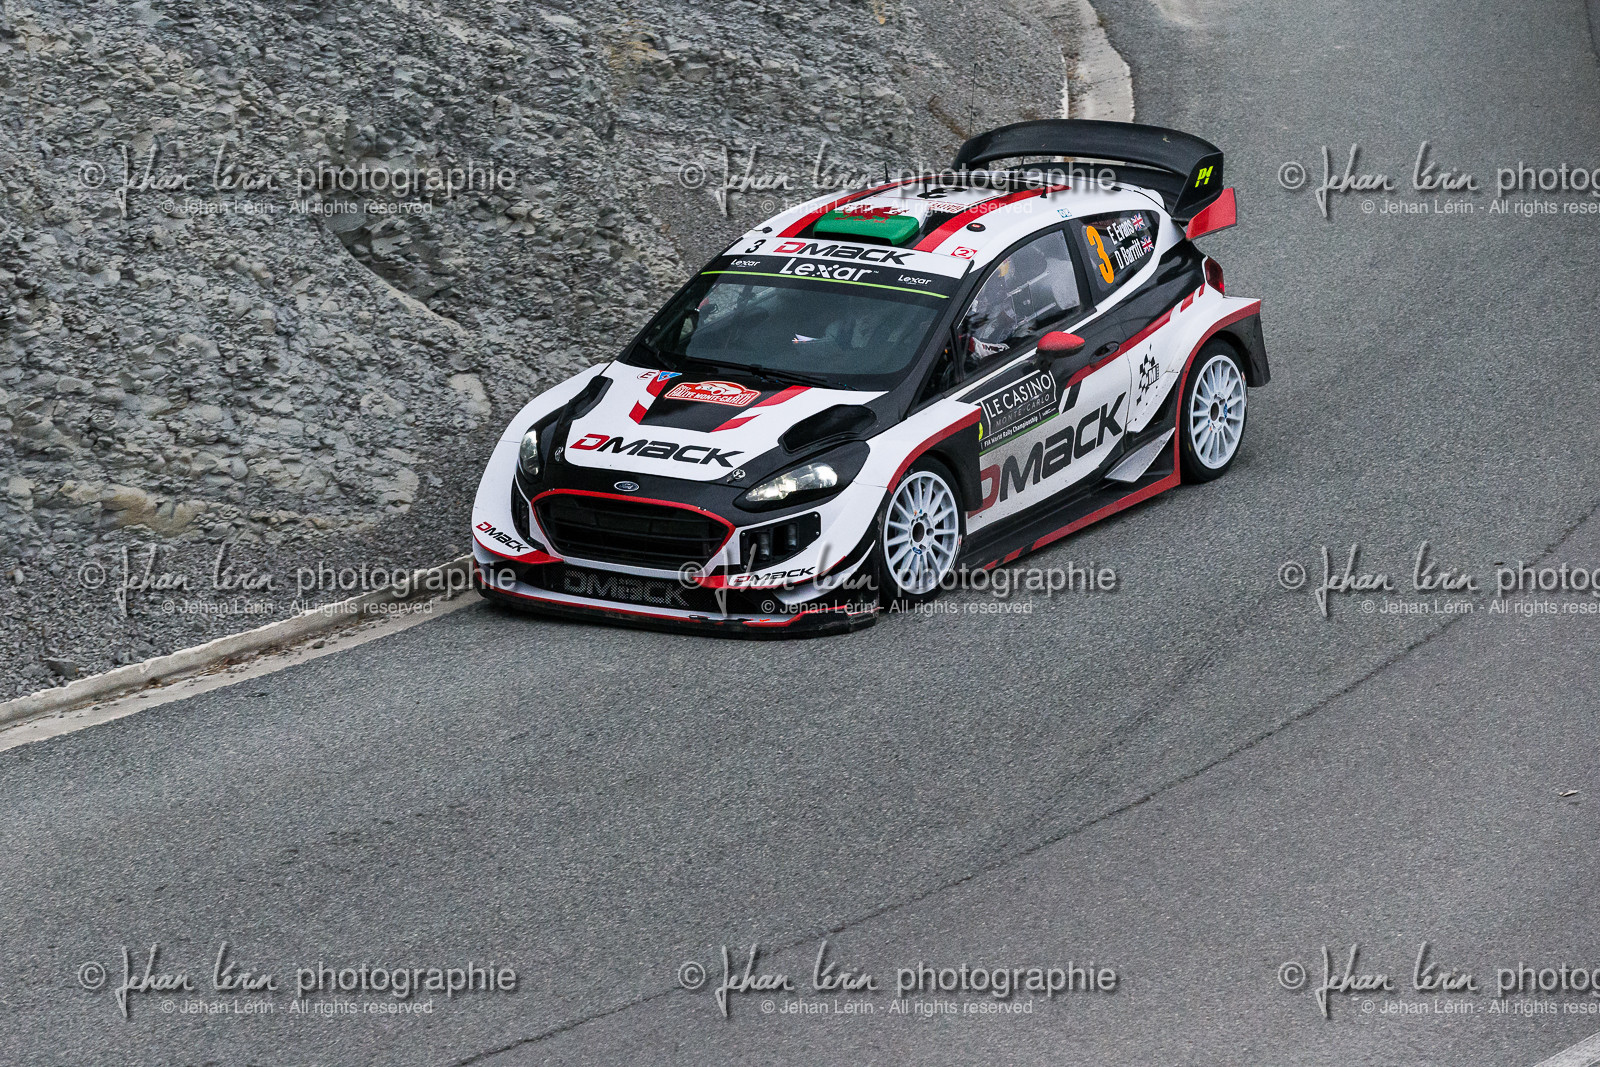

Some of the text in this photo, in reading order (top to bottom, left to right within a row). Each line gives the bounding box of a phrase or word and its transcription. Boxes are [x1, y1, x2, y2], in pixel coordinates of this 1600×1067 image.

[1107, 219, 1135, 245] E Evans
[746, 239, 766, 253] 3
[1086, 226, 1114, 284] 3
[1114, 238, 1144, 270] D Barritt
[731, 259, 761, 268] Lexar
[780, 258, 872, 281] Lexar
[898, 275, 932, 285] Lexar
[986, 374, 1051, 418] LE CASINO
[991, 432, 1003, 443] World
[1003, 428, 1013, 438] Rally
[1013, 416, 1038, 433] Championship
